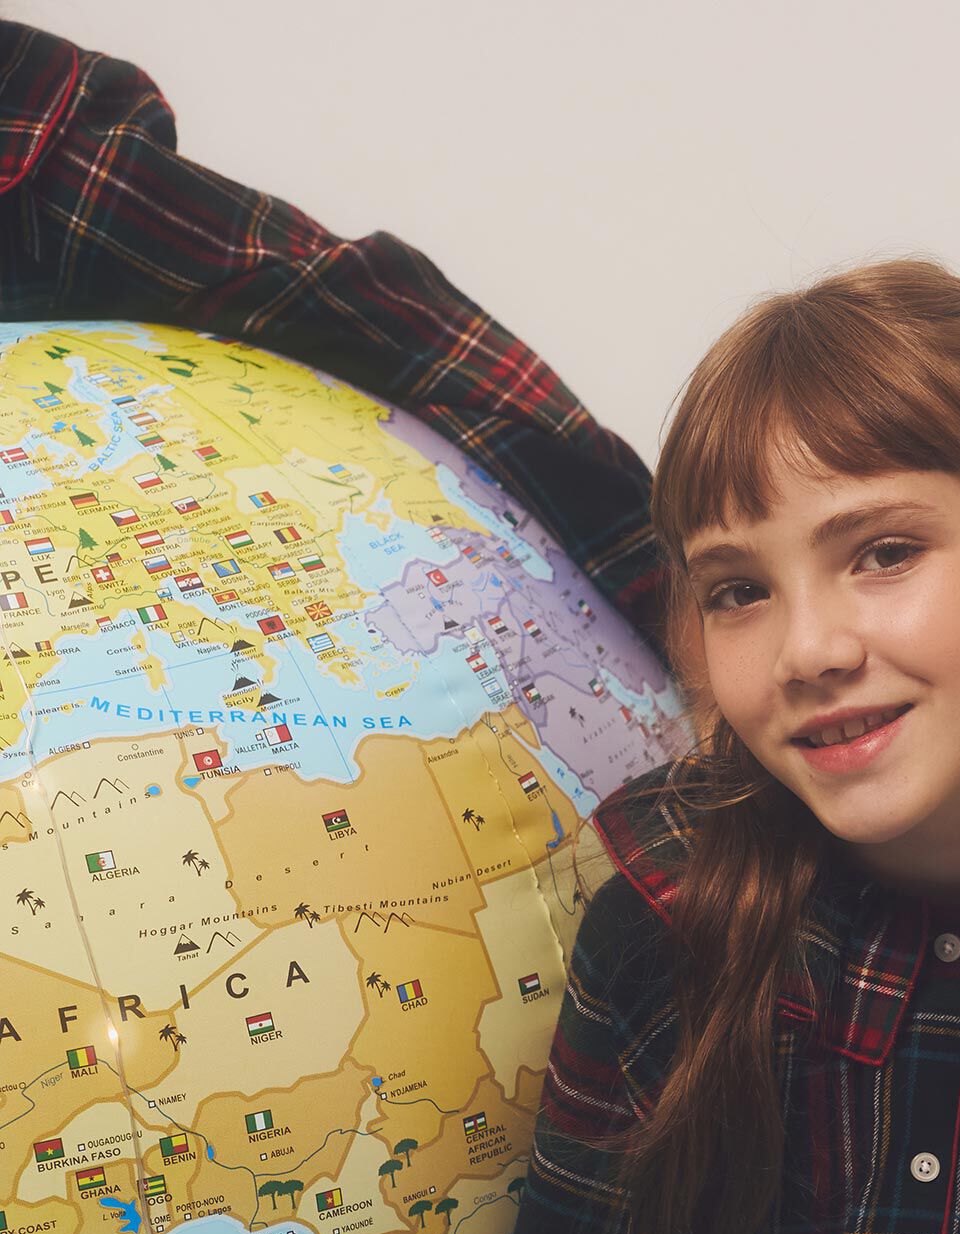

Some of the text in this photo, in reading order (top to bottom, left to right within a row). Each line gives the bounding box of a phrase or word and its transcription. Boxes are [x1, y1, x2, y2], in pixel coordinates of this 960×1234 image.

[88, 411, 123, 472] BALTIC SEA
[8, 456, 50, 470] DENMARK
[145, 483, 177, 495] POLAND
[26, 500, 66, 513] AMSTERDAM
[78, 504, 120, 516] GERMANY
[182, 506, 221, 522] SLOVAKIA
[120, 524, 148, 534] CZECH
[284, 538, 315, 551] ROMANIA
[368, 532, 404, 550] BLACK
[145, 543, 181, 556] AUSTRIA
[236, 541, 273, 556] HUNGARY
[384, 544, 406, 556] SEA
[62, 574, 82, 583] BERN
[151, 566, 193, 582] SLOVENIA
[221, 575, 249, 586] BOSNIA
[277, 578, 302, 588] SERBIA
[46, 588, 65, 597] Lyon
[182, 586, 221, 600] CROATIA
[284, 587, 317, 596] Balkan
[218, 594, 272, 612] MONTENEGRO
[3, 608, 42, 619] FRANCE
[60, 608, 81, 618] Mont
[315, 610, 358, 628] MACEDONIA
[100, 619, 136, 633] MONACO
[146, 622, 170, 632] ITALY
[178, 620, 198, 630] ROME
[176, 636, 210, 650] VATICAN
[267, 629, 302, 644] ALBANIA
[38, 646, 81, 658] ANDORRA
[106, 644, 142, 656] Corsica
[196, 644, 221, 656] Naples
[316, 646, 349, 662] GREECE
[114, 664, 153, 676] Sardinia
[384, 686, 406, 698] Crete
[226, 696, 255, 709] Sicily
[90, 696, 412, 729] MEDITERRANEAN SEA
[173, 729, 196, 741] TUNIS
[49, 743, 82, 756] ALGIERS
[117, 748, 164, 762] Constantine
[234, 742, 268, 754] VALLETTA
[272, 742, 300, 755] MALTA
[427, 748, 460, 764] Alexandria
[200, 765, 241, 780] TUNISIA
[274, 762, 302, 774] TRIPOLI
[28, 791, 152, 842] Mountains
[328, 826, 358, 842] LIBYA
[91, 866, 141, 882] ALGERIA
[432, 858, 513, 890] Nubian Desert
[324, 894, 450, 914] Tibesti Mountains
[139, 903, 278, 939] Hoggar Mountains
[176, 952, 200, 962] Tahat
[0, 960, 310, 1044] AFRICA
[522, 988, 550, 1005] SUDAN
[401, 997, 429, 1012] CHAD
[250, 1030, 284, 1046] NIGER
[71, 1066, 98, 1080] MALI
[388, 1070, 406, 1082] Chad
[40, 1072, 64, 1090] Niger
[158, 1092, 188, 1106] NIAMEY
[248, 1126, 292, 1144] NIGERIA
[466, 1124, 508, 1144] CENTRAL
[270, 1146, 295, 1159] ABUJA
[468, 1135, 506, 1156] AFRICAN
[37, 1147, 122, 1173] BURKINA FASO
[163, 1152, 197, 1167] BENIN
[469, 1143, 513, 1166] REPUBLIC
[80, 1184, 122, 1200] GHANA
[402, 1188, 429, 1204] BANGUI
[473, 1190, 498, 1206] Congo
[146, 1193, 172, 1206] OGO
[175, 1194, 226, 1213] PORTO-NOVO
[208, 1204, 232, 1218] Lagos
[318, 1198, 373, 1222] CAMEROON
